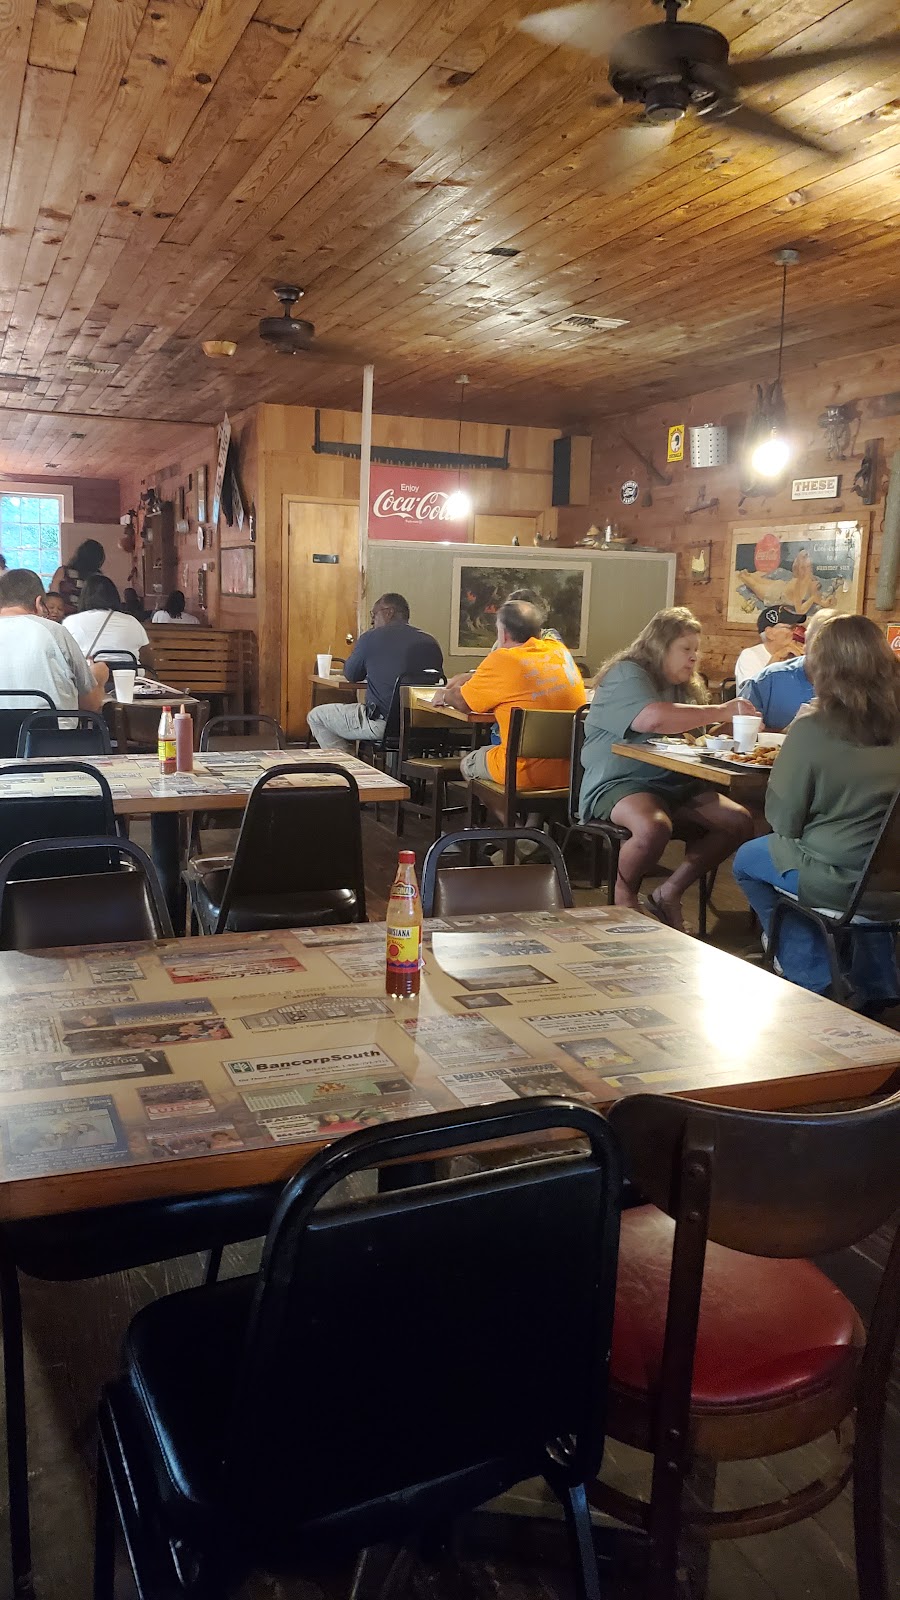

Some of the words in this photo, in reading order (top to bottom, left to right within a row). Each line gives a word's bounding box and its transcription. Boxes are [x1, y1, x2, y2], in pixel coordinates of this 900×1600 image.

[400, 483, 420, 493] Enjoy
[794, 479, 835, 492] THESE
[816, 563, 838, 571] summer
[256, 1050, 381, 1071] BancorpSouth
